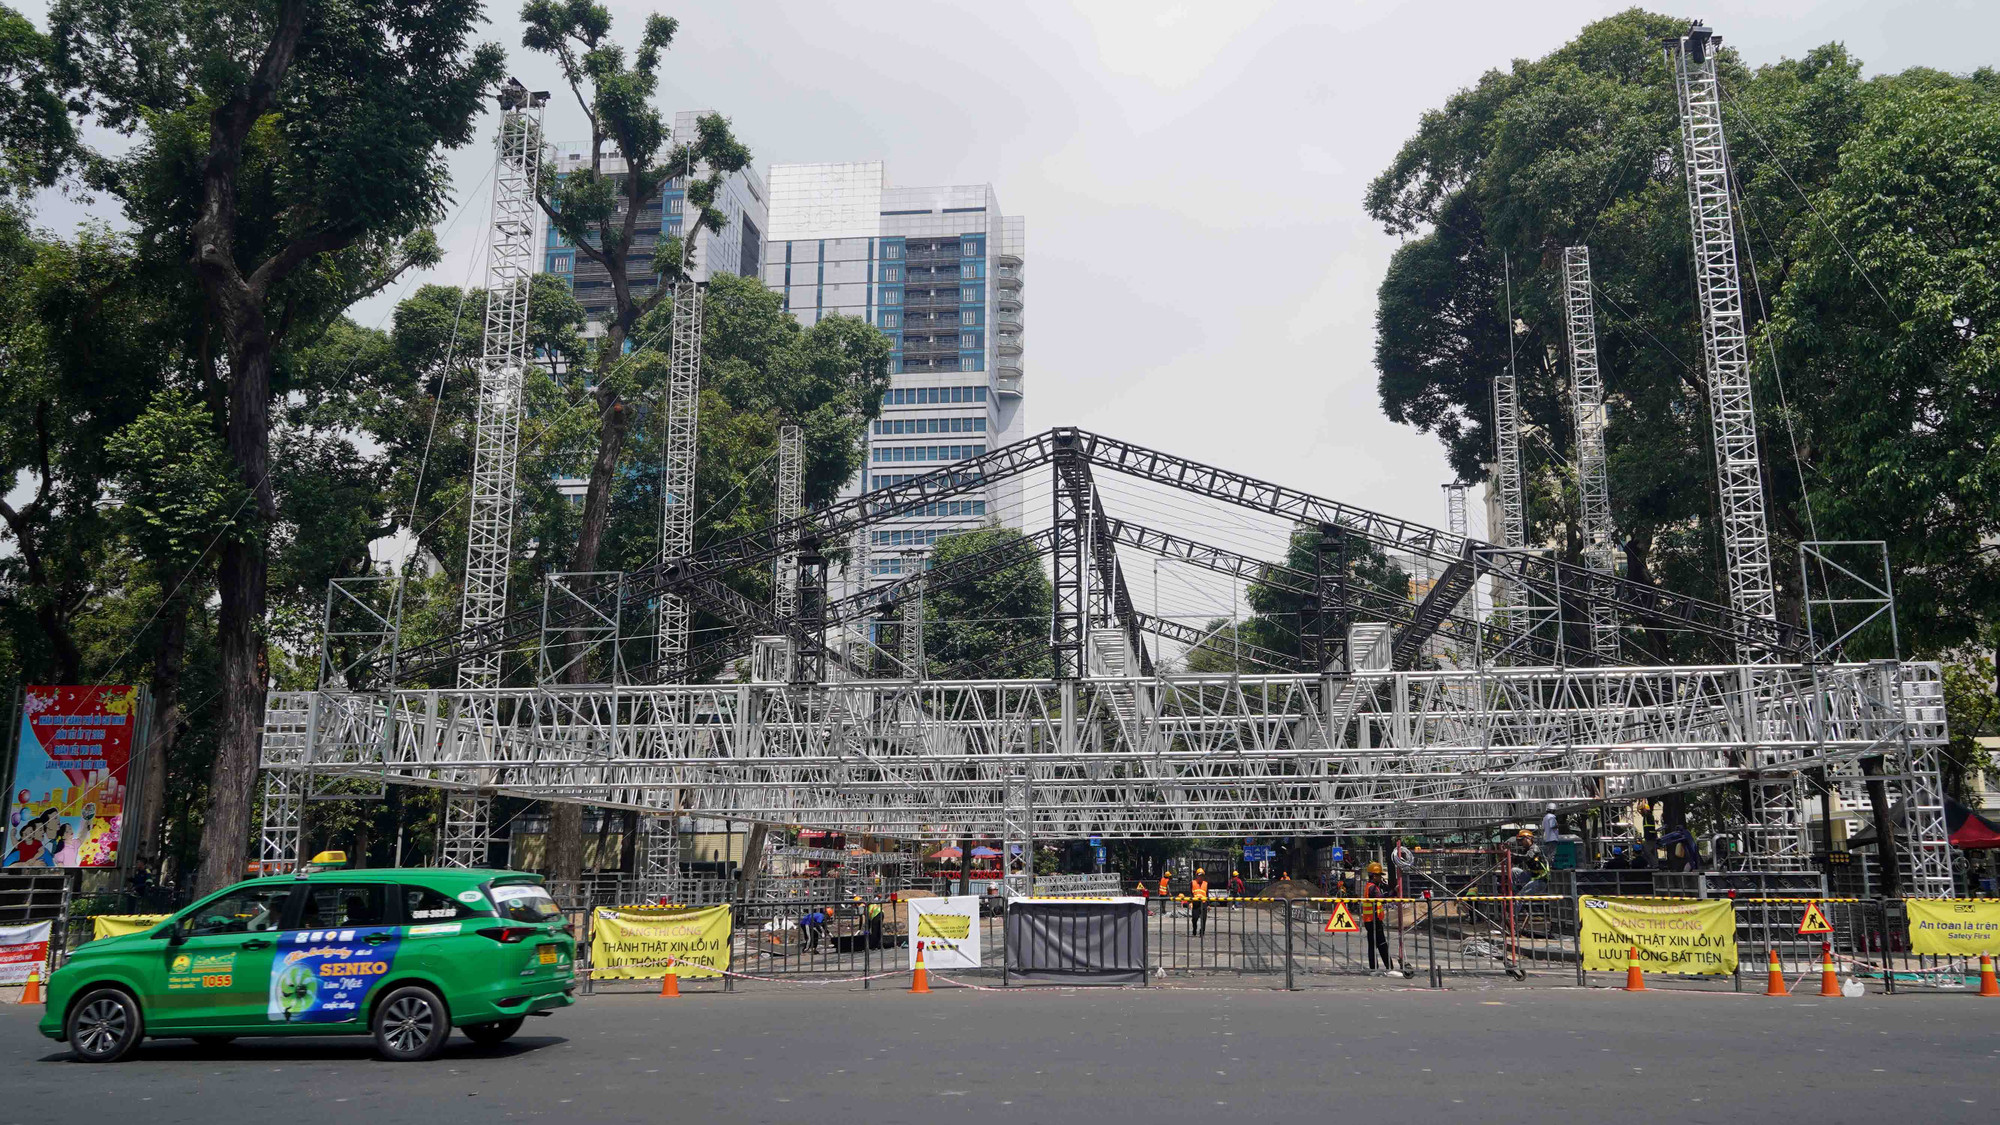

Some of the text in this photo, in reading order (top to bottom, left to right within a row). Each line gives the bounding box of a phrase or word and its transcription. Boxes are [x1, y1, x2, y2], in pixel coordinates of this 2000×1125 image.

[968, 870, 1004, 880] ORNER
[652, 926, 670, 937] THI
[672, 925, 702, 936] CÔNG
[1646, 918, 1666, 929] THI
[1668, 918, 1703, 930] CÔNG
[1919, 920, 1934, 930] An
[603, 938, 719, 954] THÀNH THẬT XIN LỖI VÌ
[1592, 931, 1725, 948] THÀNH THẬT XIN LỖI VÌ
[608, 956, 628, 968] LƯU
[630, 956, 668, 968] THÔNG
[673, 954, 690, 966] ẤT
[1599, 948, 1622, 960] LƯU
[1672, 950, 1692, 962] BẤT
[1694, 950, 1722, 966] TIỆN
[320, 962, 387, 976] SENKO
[202, 974, 232, 988] 1055
